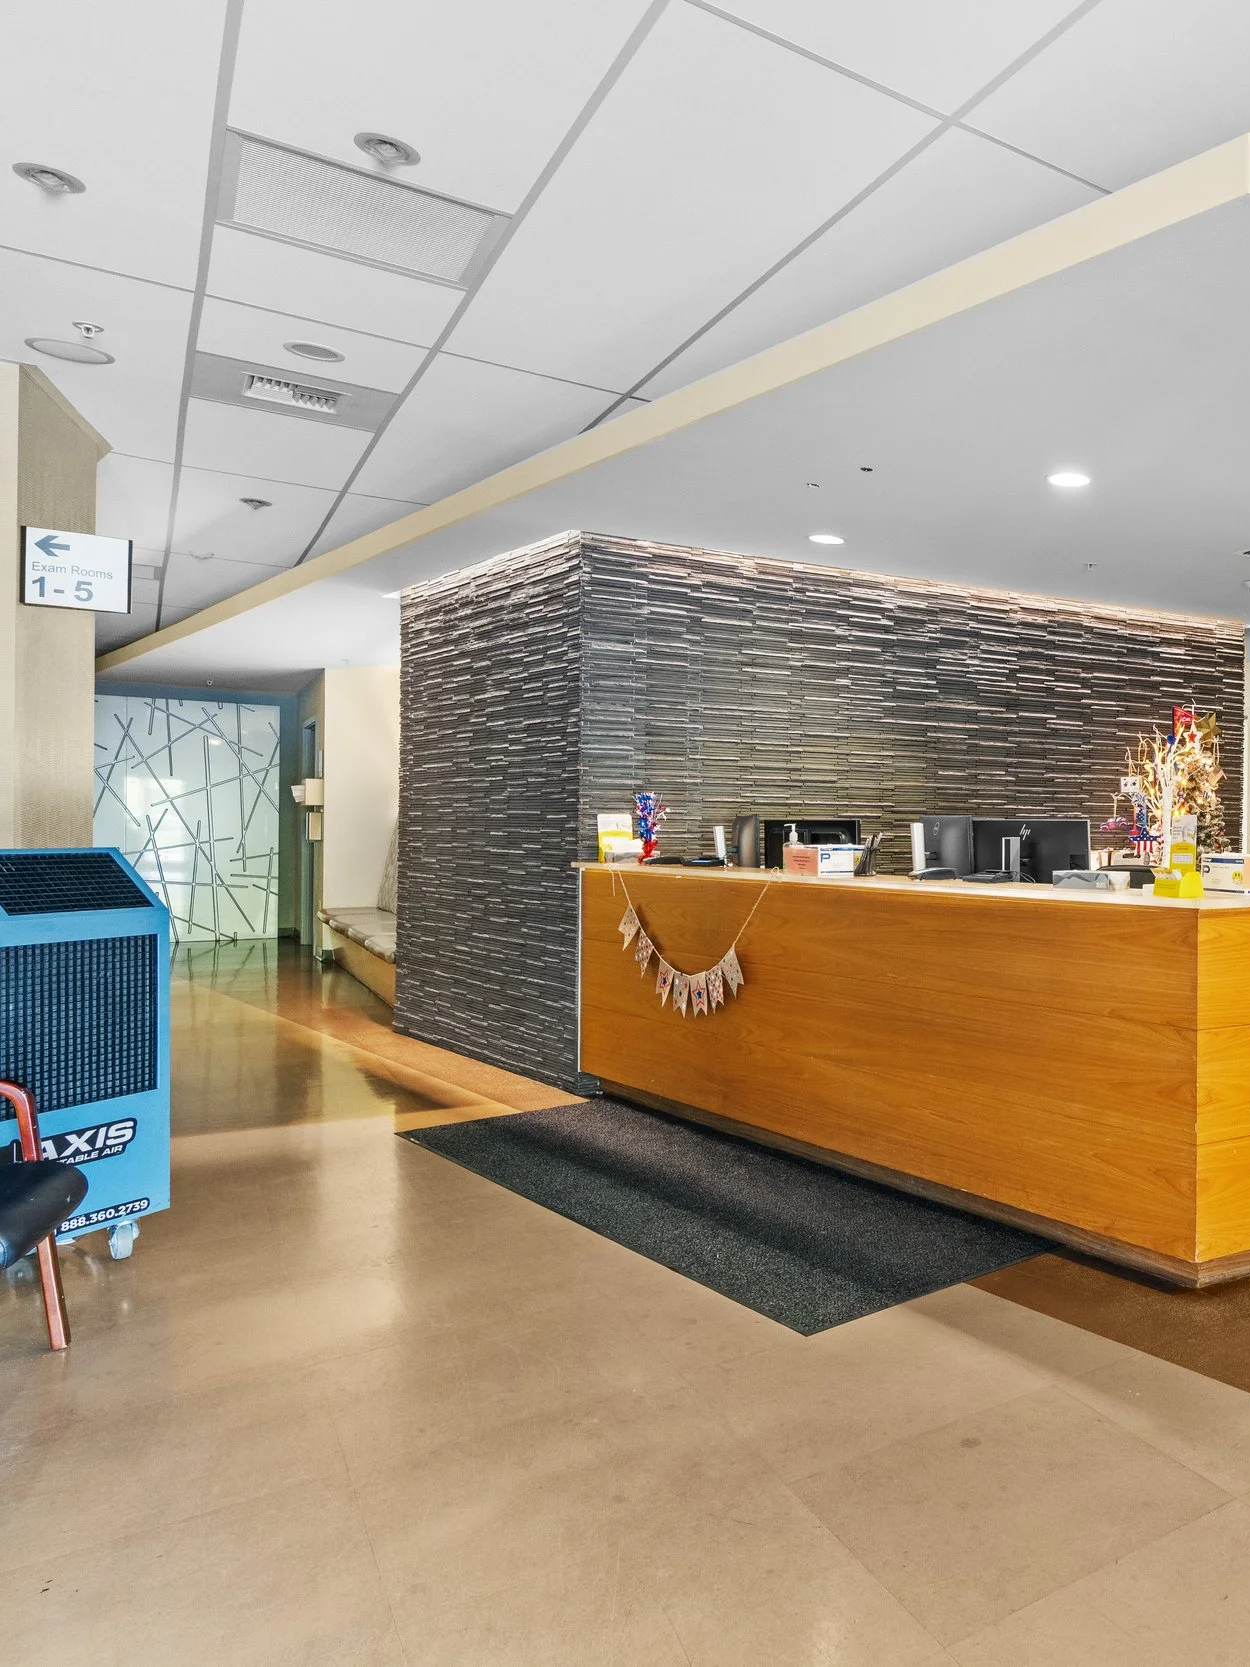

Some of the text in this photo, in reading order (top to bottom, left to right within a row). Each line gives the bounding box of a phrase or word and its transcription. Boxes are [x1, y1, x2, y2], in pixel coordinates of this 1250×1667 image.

[32, 561, 113, 580] Exam Rooms
[14, 1120, 135, 1163] AXIS
[101, 1144, 124, 1156] AIR
[60, 1199, 149, 1232] 888.360.2739
